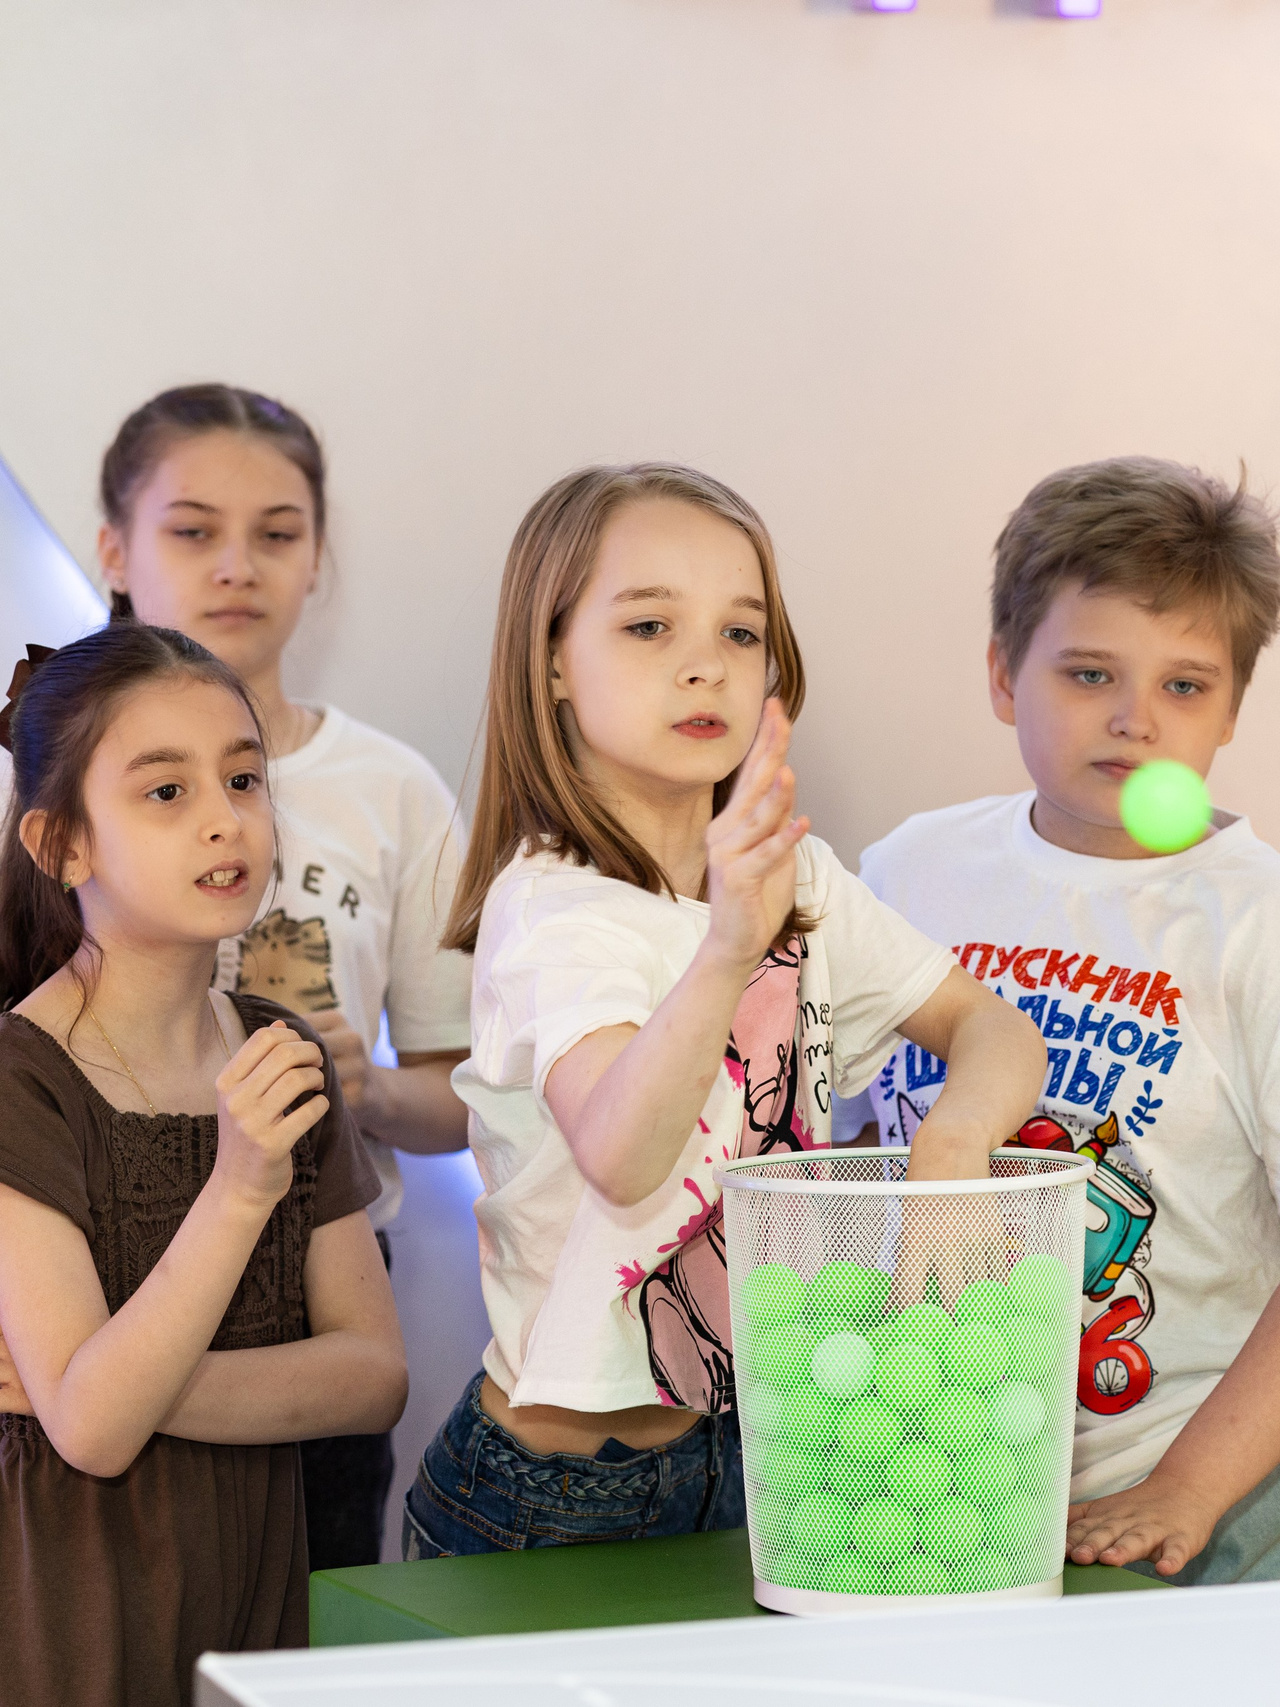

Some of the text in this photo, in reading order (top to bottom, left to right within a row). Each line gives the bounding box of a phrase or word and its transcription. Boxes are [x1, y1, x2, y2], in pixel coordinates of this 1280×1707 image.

[951, 942, 1183, 1026] ПУСКНИК
[996, 985, 1183, 1075] ЛЬНОЙ
[906, 1042, 1126, 1117] ШЛЫ
